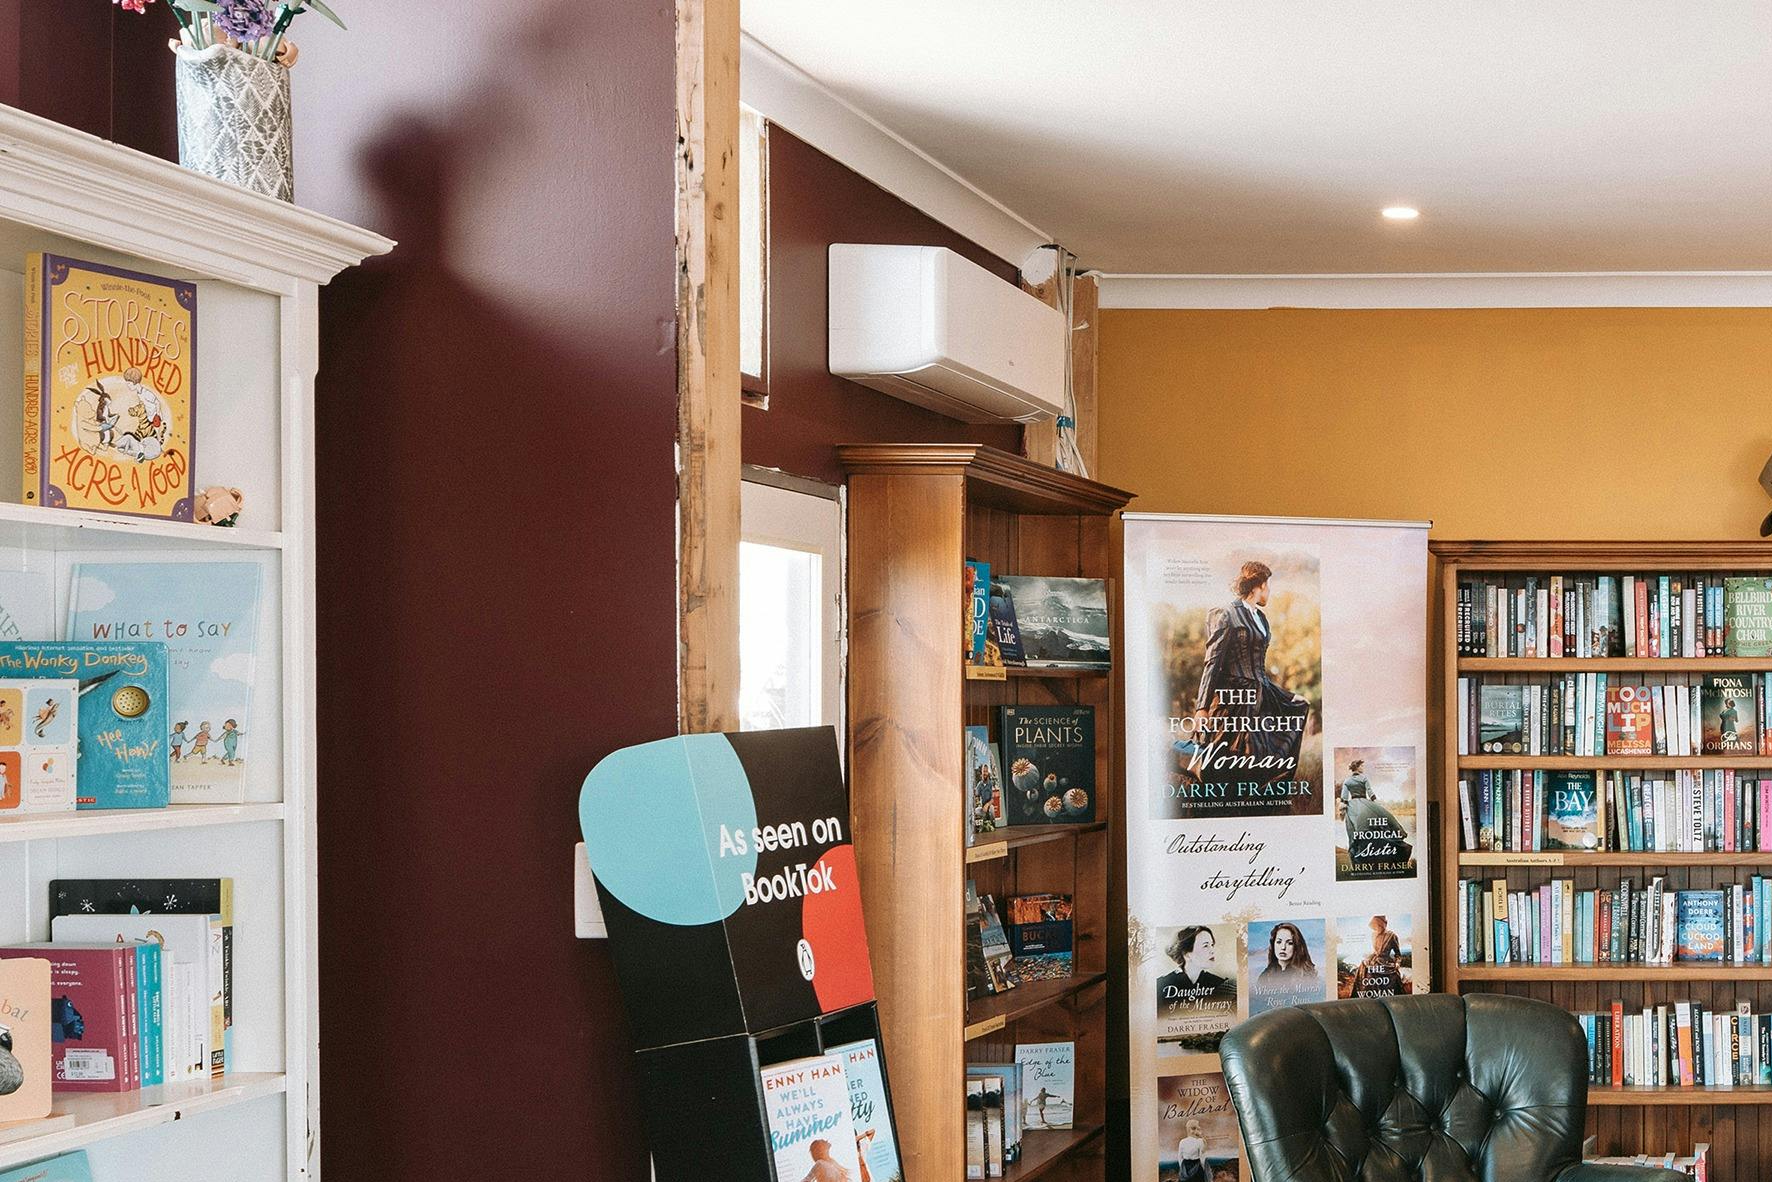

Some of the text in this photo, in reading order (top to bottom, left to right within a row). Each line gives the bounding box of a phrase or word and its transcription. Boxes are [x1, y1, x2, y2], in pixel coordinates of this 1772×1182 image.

[81, 337, 182, 396] HUNDRED
[1736, 604, 1766, 616] RIVER
[1713, 679, 1743, 687] FIONA
[1215, 689, 1257, 705] THE
[1608, 686, 1651, 702] TOO
[1489, 707, 1516, 718] RITES
[1608, 701, 1650, 713] MUCH
[1169, 715, 1305, 733] FORTHRIGHT
[1608, 713, 1650, 733] LIP
[1015, 727, 1083, 743] PLANTS
[1607, 740, 1651, 748] MELISSA
[1187, 742, 1296, 771] Woman
[1162, 781, 1312, 799] DARRY FRASER
[1567, 782, 1582, 791] THE
[1554, 790, 1594, 812] BAY
[1367, 817, 1388, 826] THE
[719, 816, 842, 858] As seen on
[1353, 830, 1402, 840] PRODIGAL
[1341, 861, 1413, 871] DARRY FRASER
[741, 860, 837, 905] BookTok
[1683, 899, 1719, 908] ANTHONY
[1684, 922, 1717, 932] CLOUD
[1682, 932, 1720, 941] CUCKOO
[1687, 941, 1715, 950] LAND
[1366, 964, 1385, 974] THE
[1361, 976, 1390, 987] GOOD
[1163, 983, 1215, 1001] Daughter
[1357, 989, 1395, 998] WOMAN
[1168, 999, 1232, 1015] of the Murray
[1167, 1022, 1230, 1033] DARRY FRASER
[1731, 1016, 1739, 1062] CIRCE
[850, 1048, 875, 1063] HAN
[1020, 1055, 1072, 1073] Edge of the
[1191, 1078, 1207, 1087] THE
[1178, 1085, 1219, 1098] WIDOW
[776, 1099, 824, 1119] ALWAYS
[770, 1110, 843, 1153] Summer
